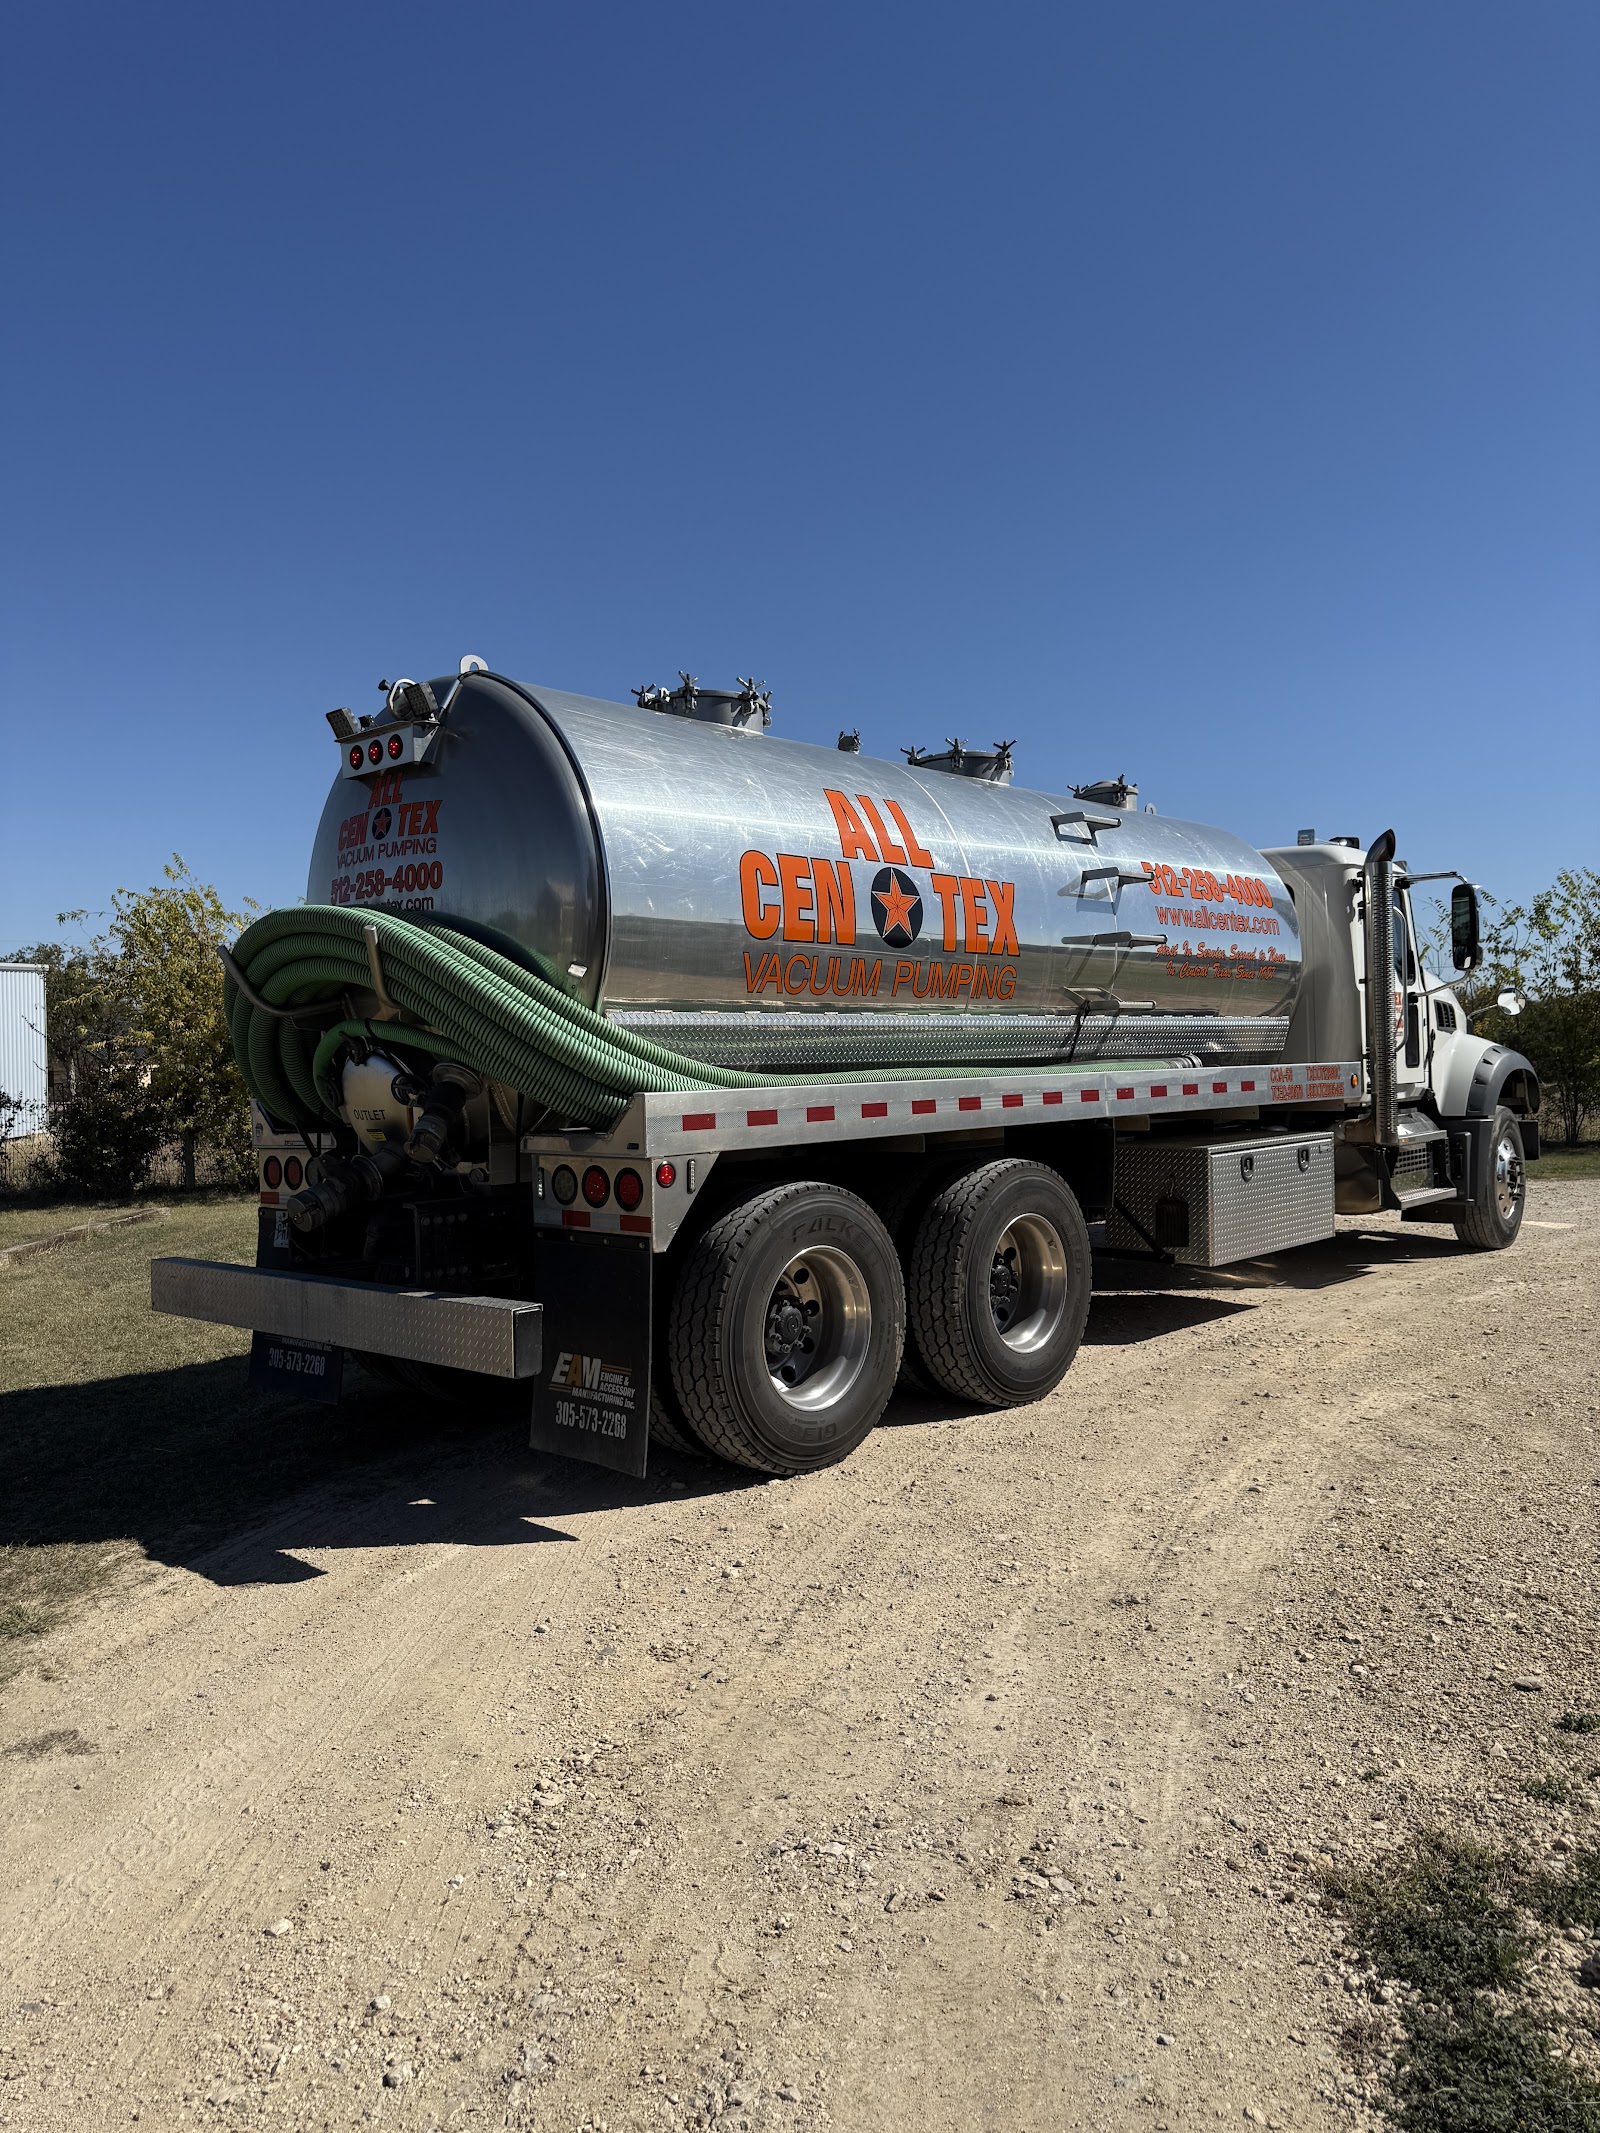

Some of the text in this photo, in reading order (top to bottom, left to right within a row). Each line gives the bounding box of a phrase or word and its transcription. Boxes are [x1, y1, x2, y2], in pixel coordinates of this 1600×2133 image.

[368, 771, 404, 809] ALL
[338, 799, 443, 852] CEN TEX
[823, 788, 935, 869] ALL
[337, 837, 438, 869] VACUUM PUMPING
[331, 860, 443, 905] 512-258-4000
[1140, 861, 1274, 909] 512-258-4000
[739, 850, 1021, 956] CEN TEX
[1155, 906, 1281, 935] www.allcentex.com
[743, 952, 1017, 1000] VACUUM PUMPING
[1179, 961, 1210, 979] Central
[1212, 961, 1233, 979] Texas
[1235, 964, 1255, 980] Since
[353, 1109, 386, 1121] OUTLET
[268, 1347, 326, 1376] 305-573-2268
[551, 1351, 602, 1390] EAM
[600, 1372, 630, 1386] ENGINE &
[571, 1387, 624, 1406] MANUFACTURING
[599, 1383, 636, 1398] ACCESSORY
[555, 1400, 627, 1440] 305-573-2268
